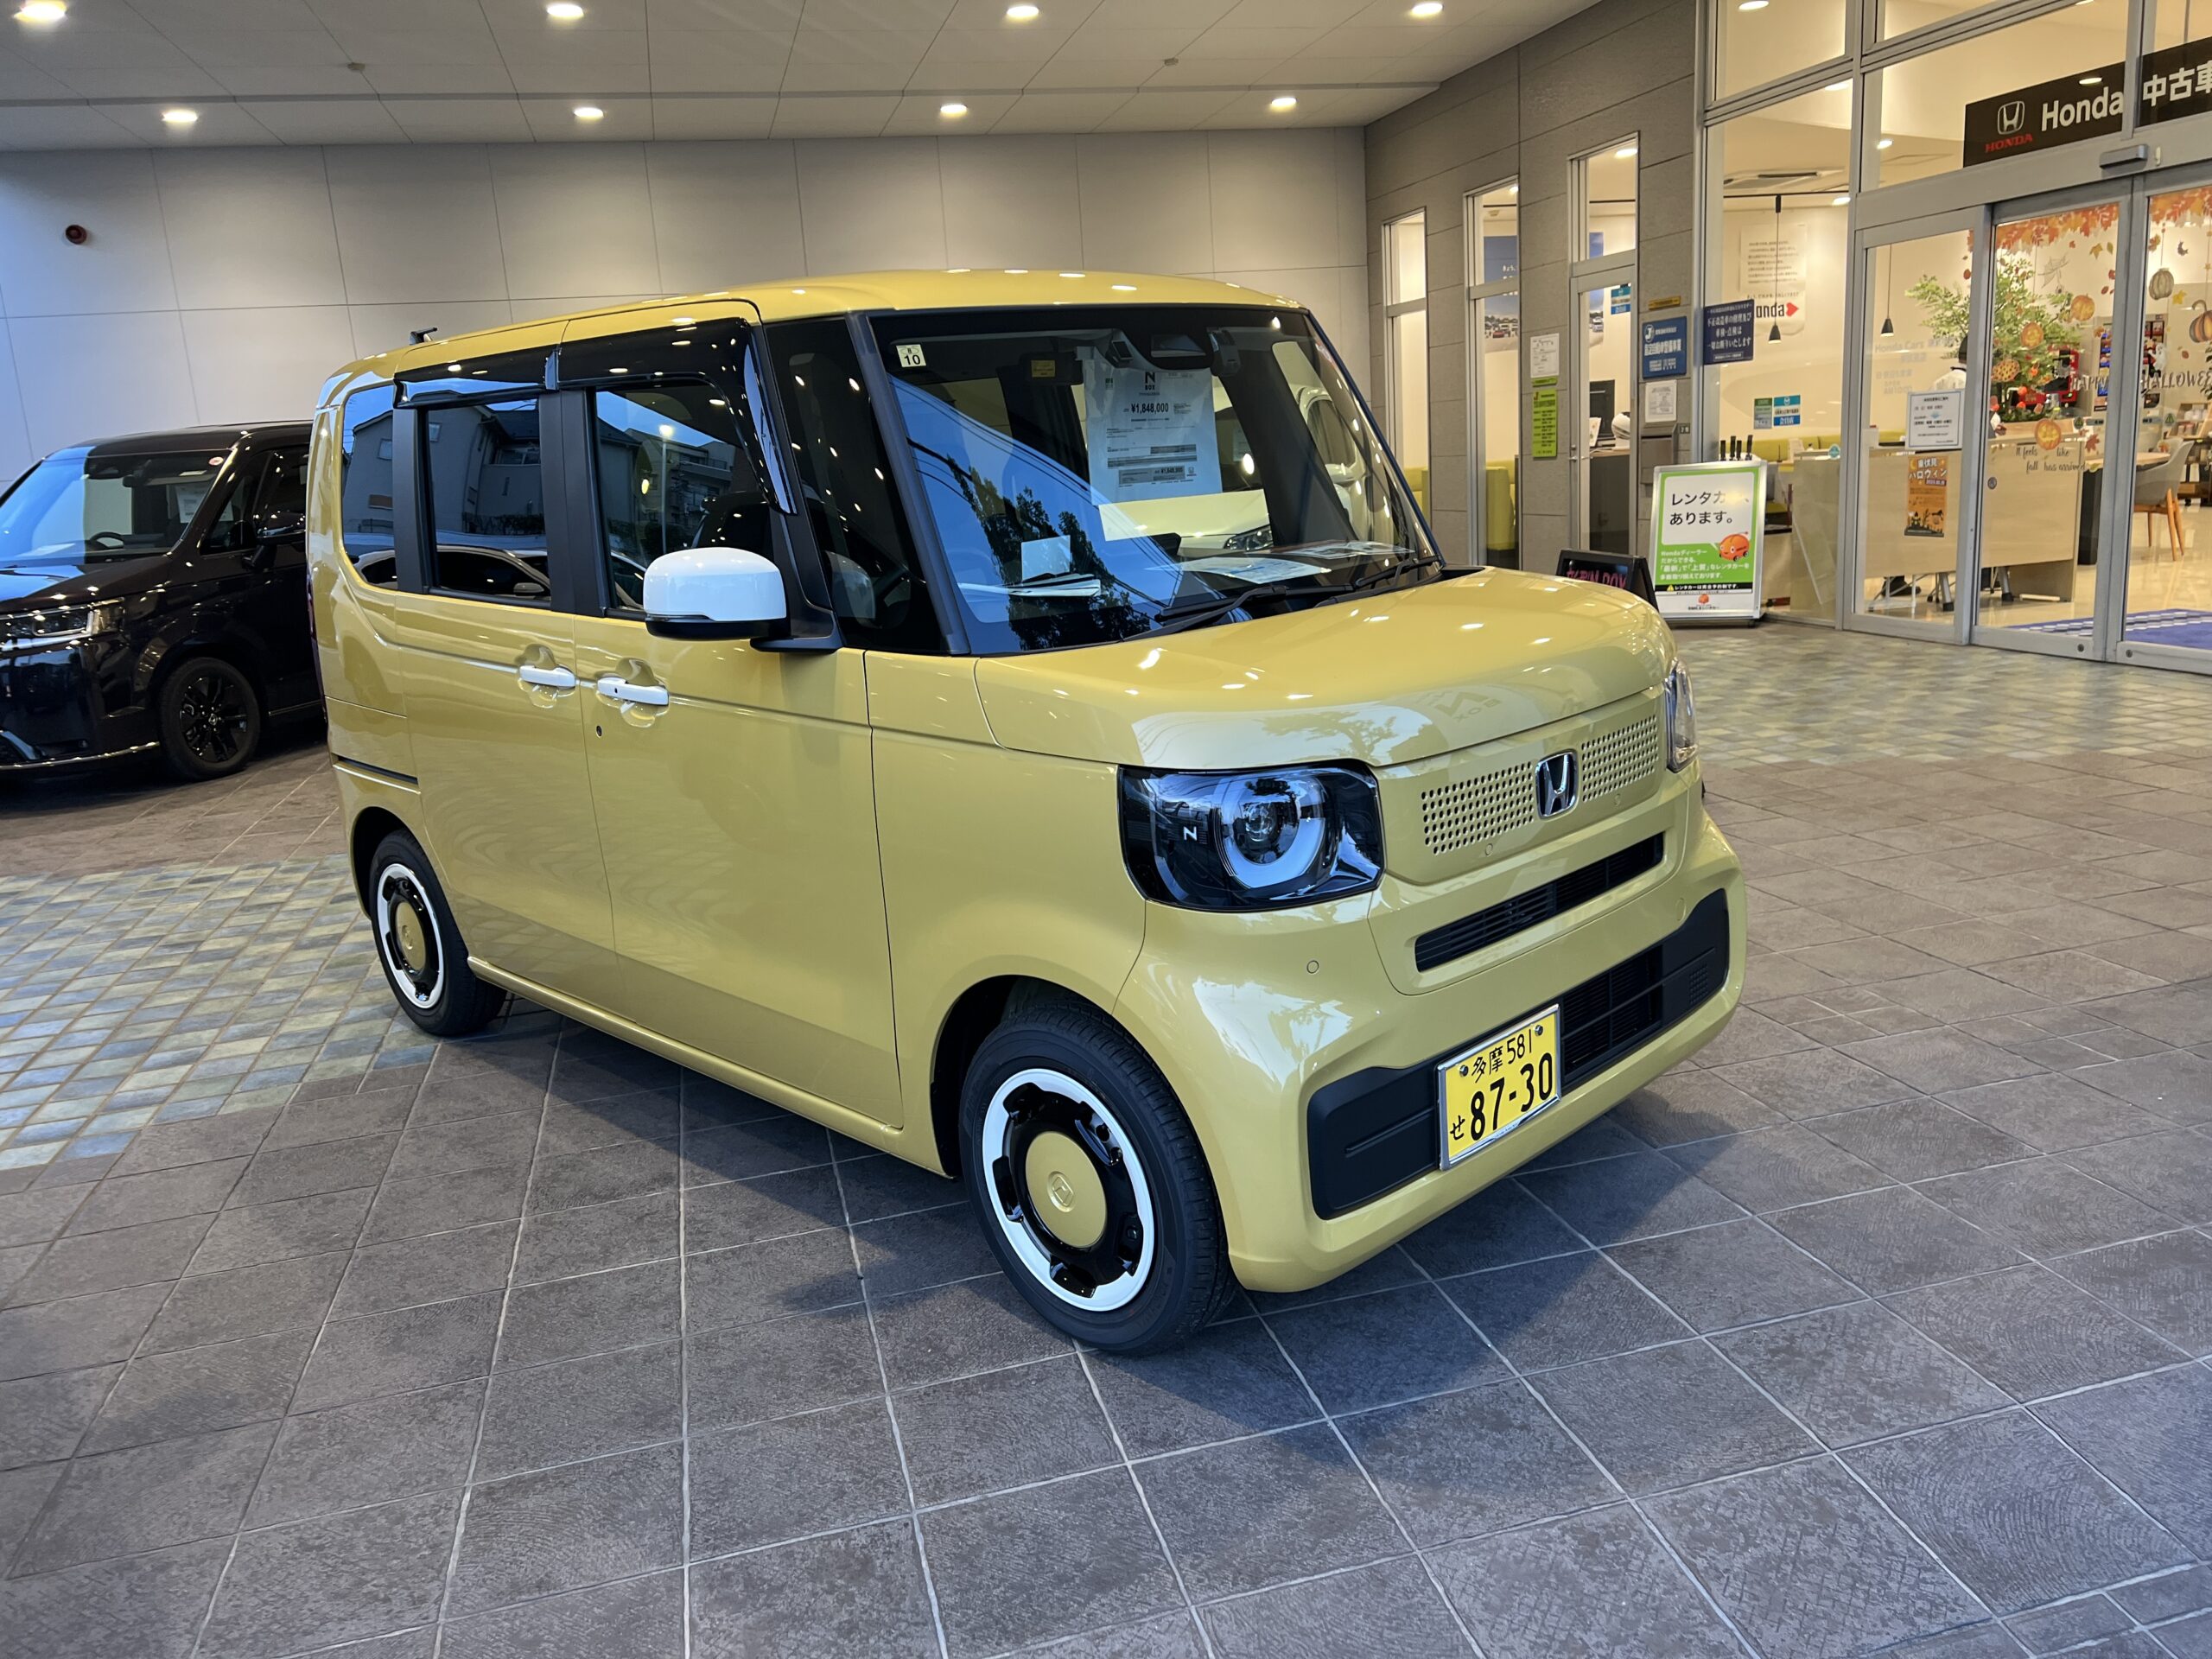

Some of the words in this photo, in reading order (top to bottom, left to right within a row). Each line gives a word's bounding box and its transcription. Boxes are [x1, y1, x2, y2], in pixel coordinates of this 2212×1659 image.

[2041, 86, 2124, 131] Honda
[1985, 133, 2033, 153] HONDA
[1756, 304, 1785, 318] onda
[904, 354, 921, 365] 10
[1145, 372, 1156, 384] N
[1131, 402, 1169, 415] ¥1,848,000
[2023, 446, 2037, 460] feels
[2056, 448, 2069, 457] like
[1909, 468, 1948, 480] ハロウィン
[2026, 461, 2038, 474] fall
[2044, 461, 2056, 471] has
[2059, 461, 2085, 471] arrived
[1669, 511, 1732, 525] あります。
[1183, 826, 1198, 841] N
[1471, 1045, 1503, 1084] 多摩
[1506, 1028, 1532, 1065] 581
[1449, 1115, 1465, 1141] せ
[1470, 1052, 1553, 1141] 87-30
